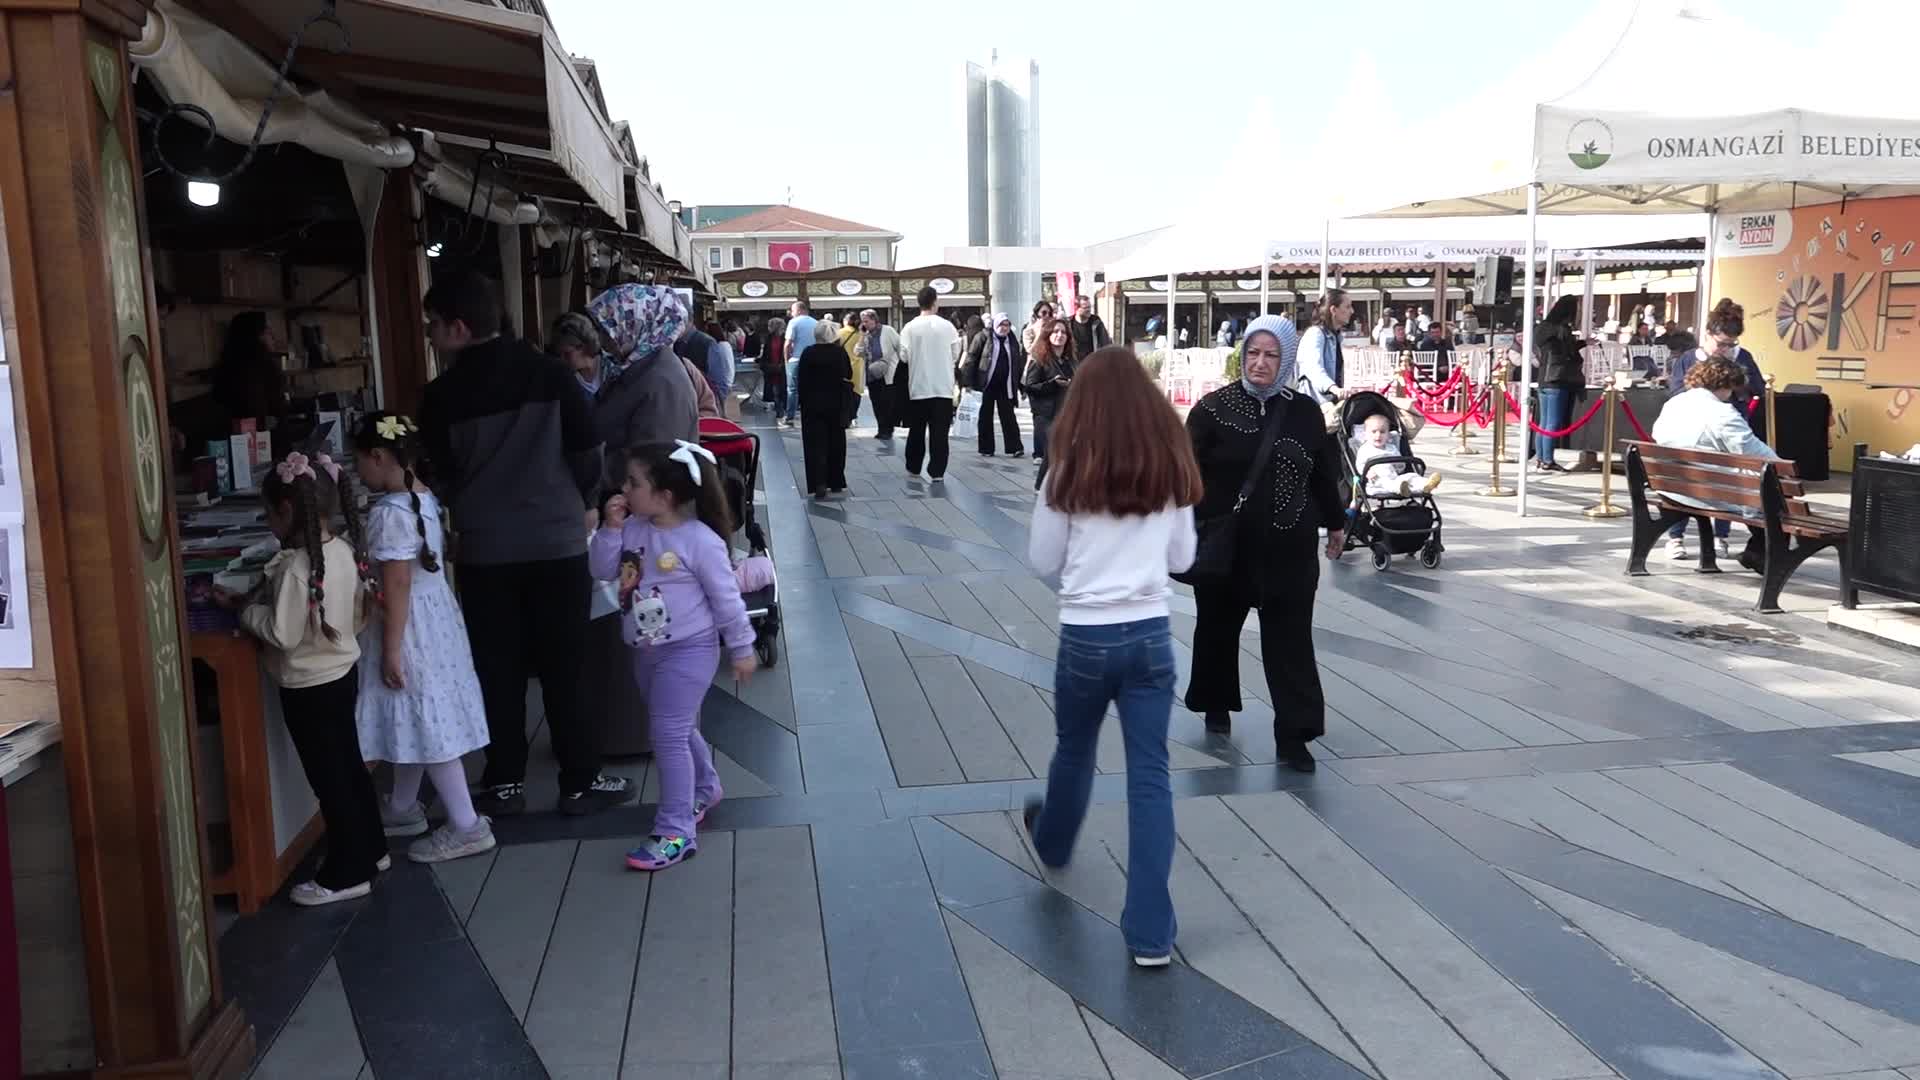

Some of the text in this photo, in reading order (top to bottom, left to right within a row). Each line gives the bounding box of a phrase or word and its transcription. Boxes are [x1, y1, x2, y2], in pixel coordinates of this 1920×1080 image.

[1647, 129, 1785, 158] OSMANGAZİ
[1741, 215, 1775, 229] ERKAN
[1741, 229, 1773, 243] AYDIN
